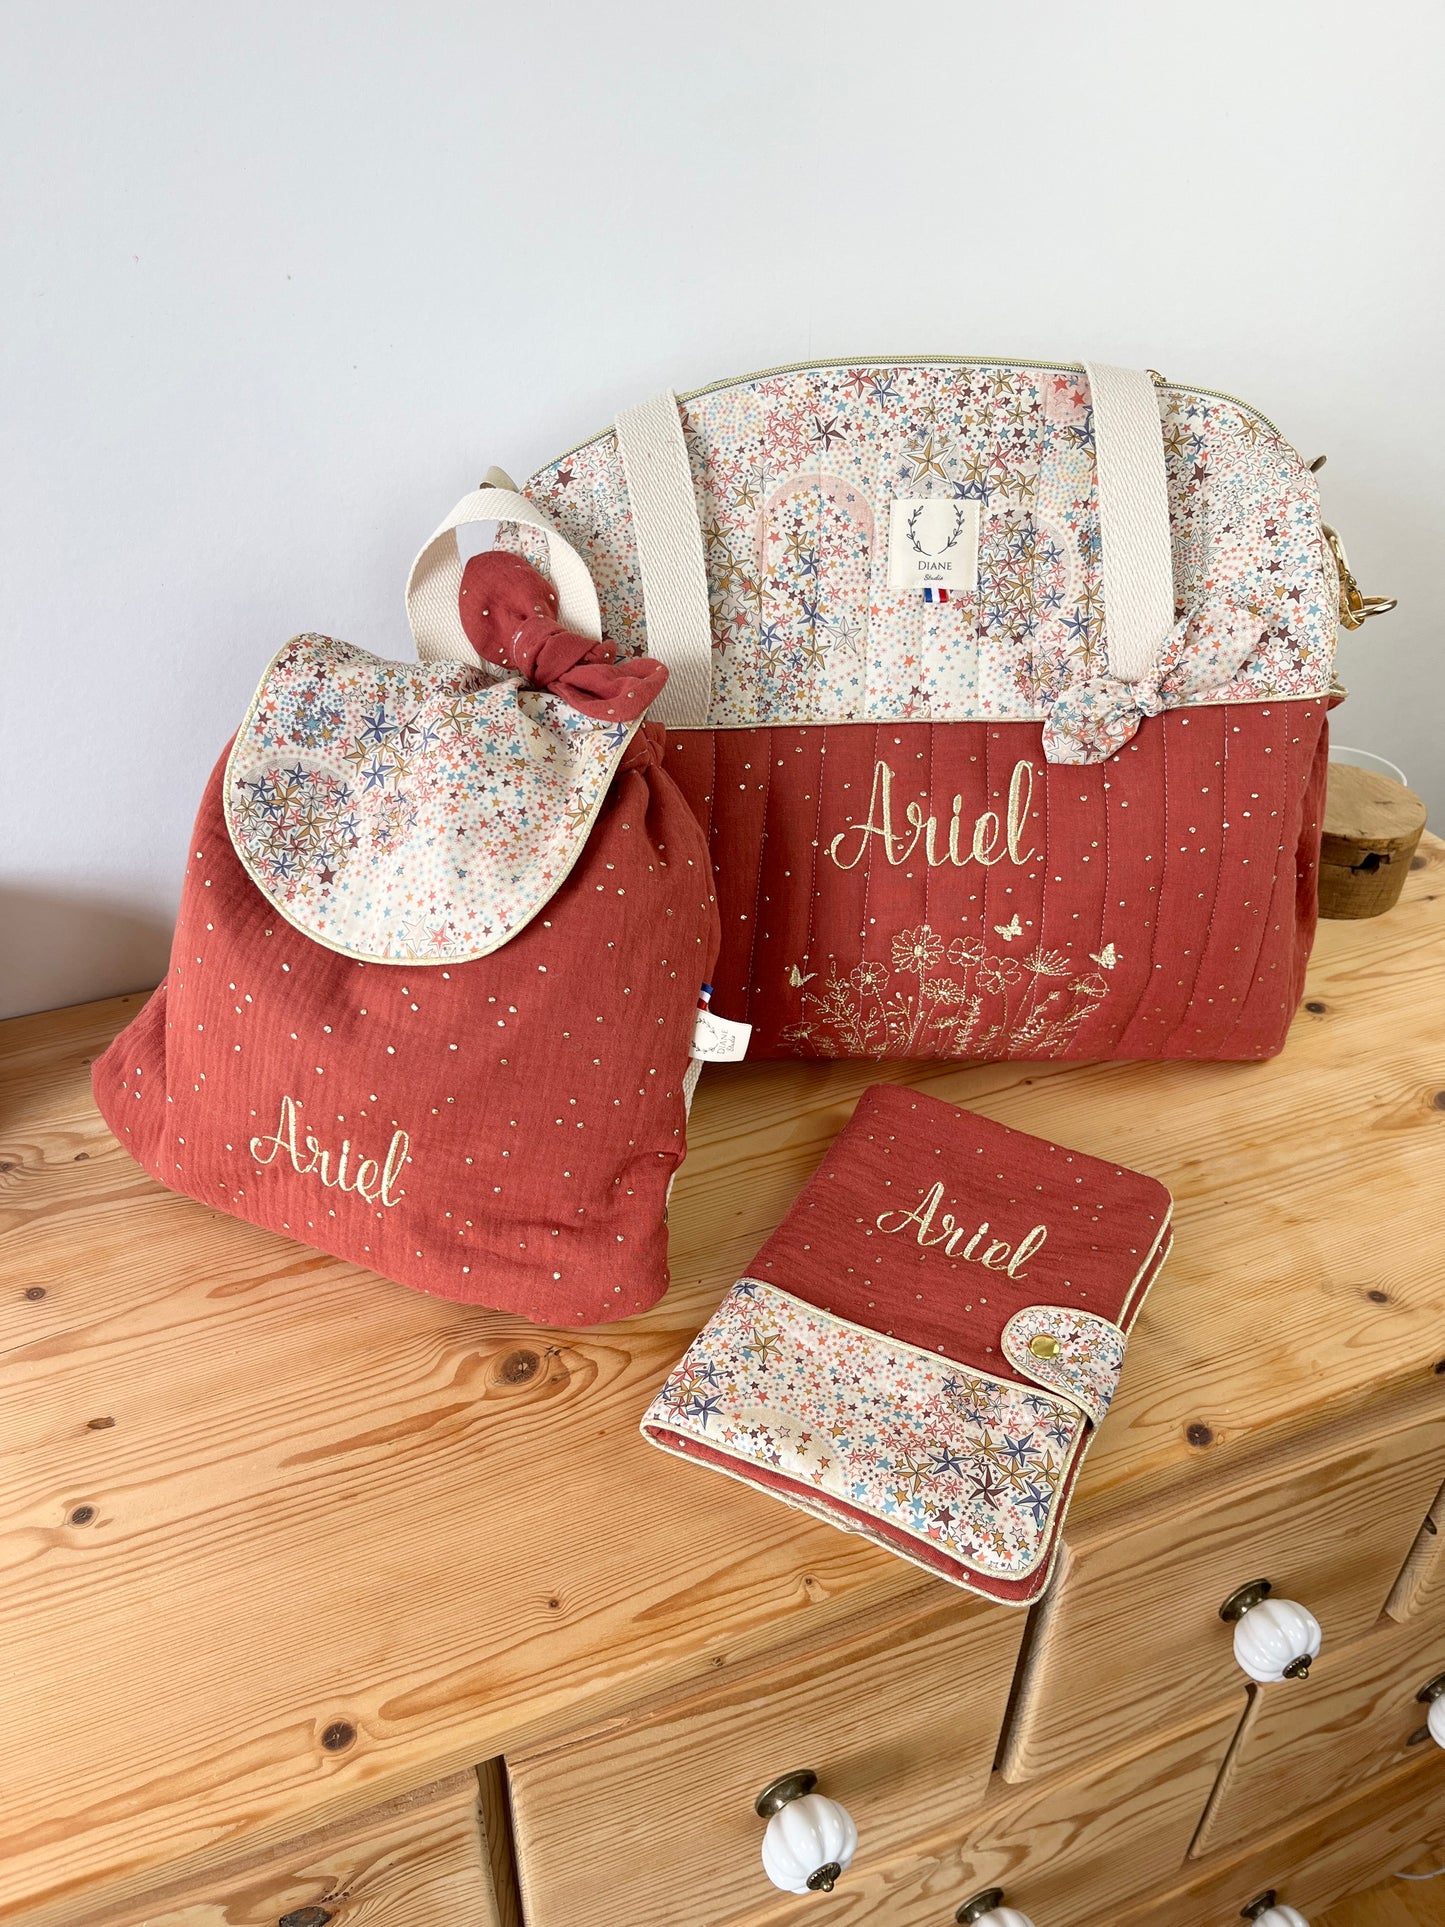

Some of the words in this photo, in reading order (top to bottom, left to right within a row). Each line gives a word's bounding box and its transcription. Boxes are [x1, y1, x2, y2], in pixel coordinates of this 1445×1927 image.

[918, 561, 952, 571] DIANE
[830, 760, 1035, 870] Ariel
[717, 1029, 729, 1055] DIANE
[250, 1095, 409, 1207] Ariel
[876, 1181, 1048, 1280] Ariel
